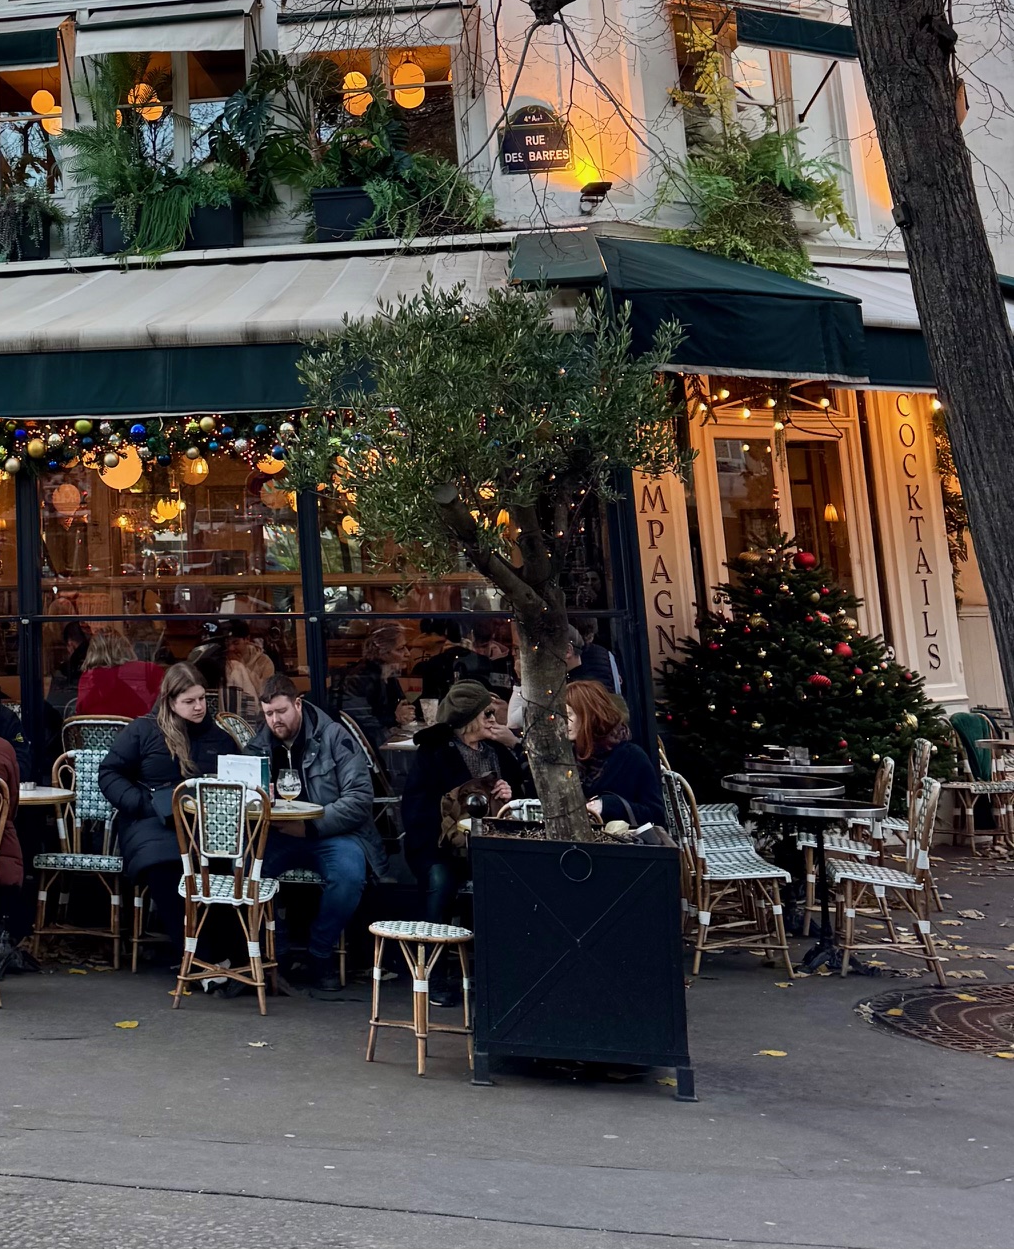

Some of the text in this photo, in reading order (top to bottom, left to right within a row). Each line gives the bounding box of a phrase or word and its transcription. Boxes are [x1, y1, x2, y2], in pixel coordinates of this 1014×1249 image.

[505, 149, 569, 163] DES BARRES
[525, 134, 546, 146] RUE
[639, 460, 676, 677] MPAGN
[895, 393, 942, 671] COCKTAILS
